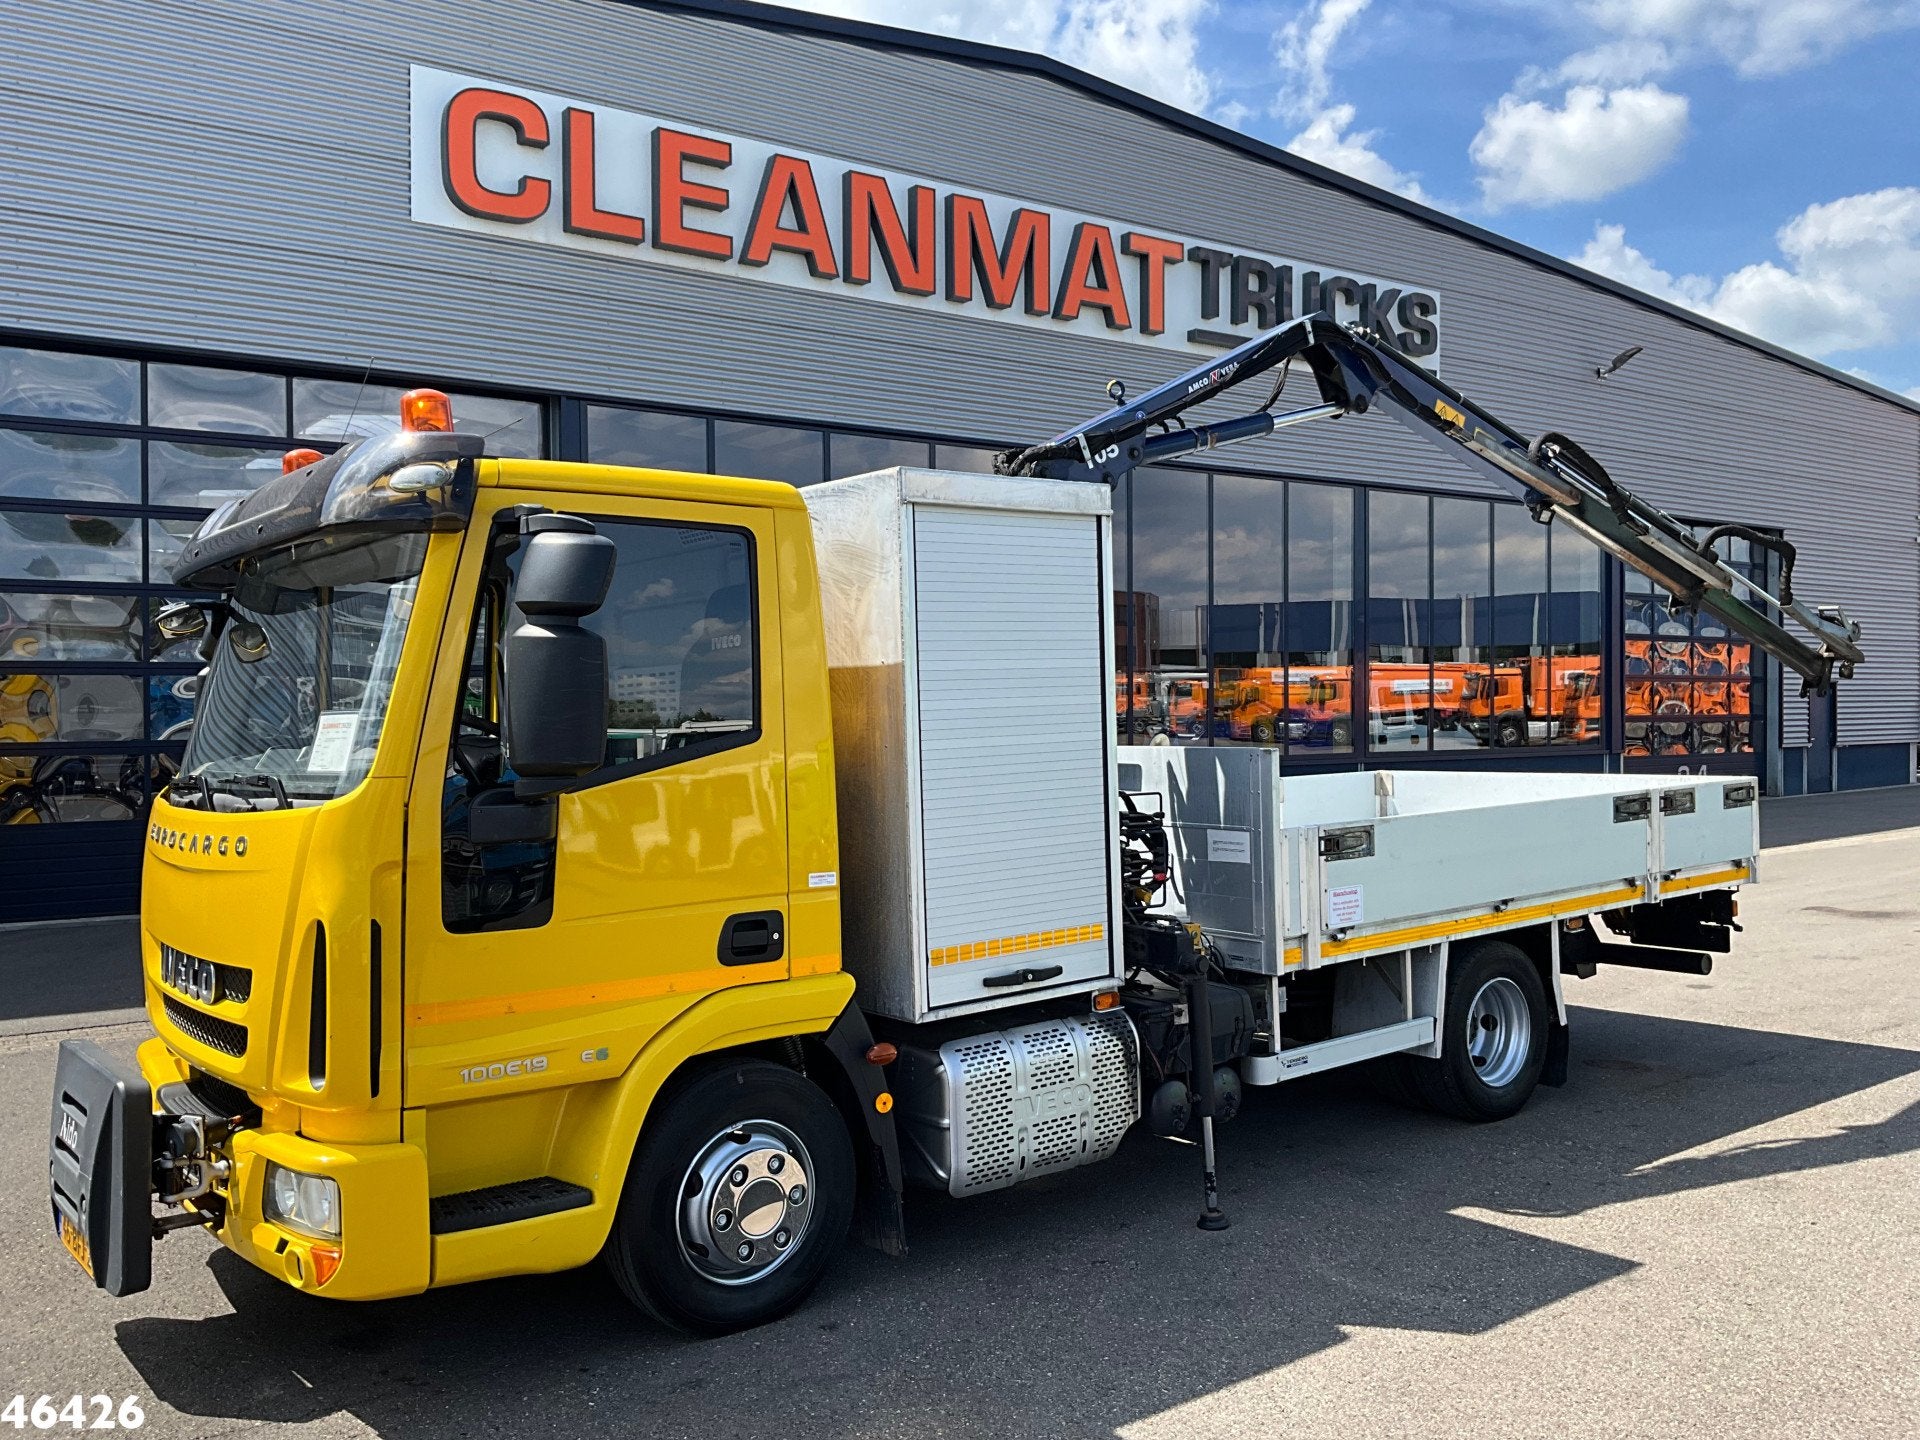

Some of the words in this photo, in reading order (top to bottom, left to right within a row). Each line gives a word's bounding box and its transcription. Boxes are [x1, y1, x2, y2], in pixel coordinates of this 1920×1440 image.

[441, 87, 1184, 335] CLEANMAT
[1187, 246, 1438, 357] TRUCKS
[1188, 377, 1209, 394] AMCO
[711, 634, 742, 651] IVECO
[150, 822, 248, 857] EUROCARGO
[162, 943, 216, 1005] IVECO
[460, 1056, 548, 1084] 100E19
[1014, 1083, 1091, 1121] IVECO
